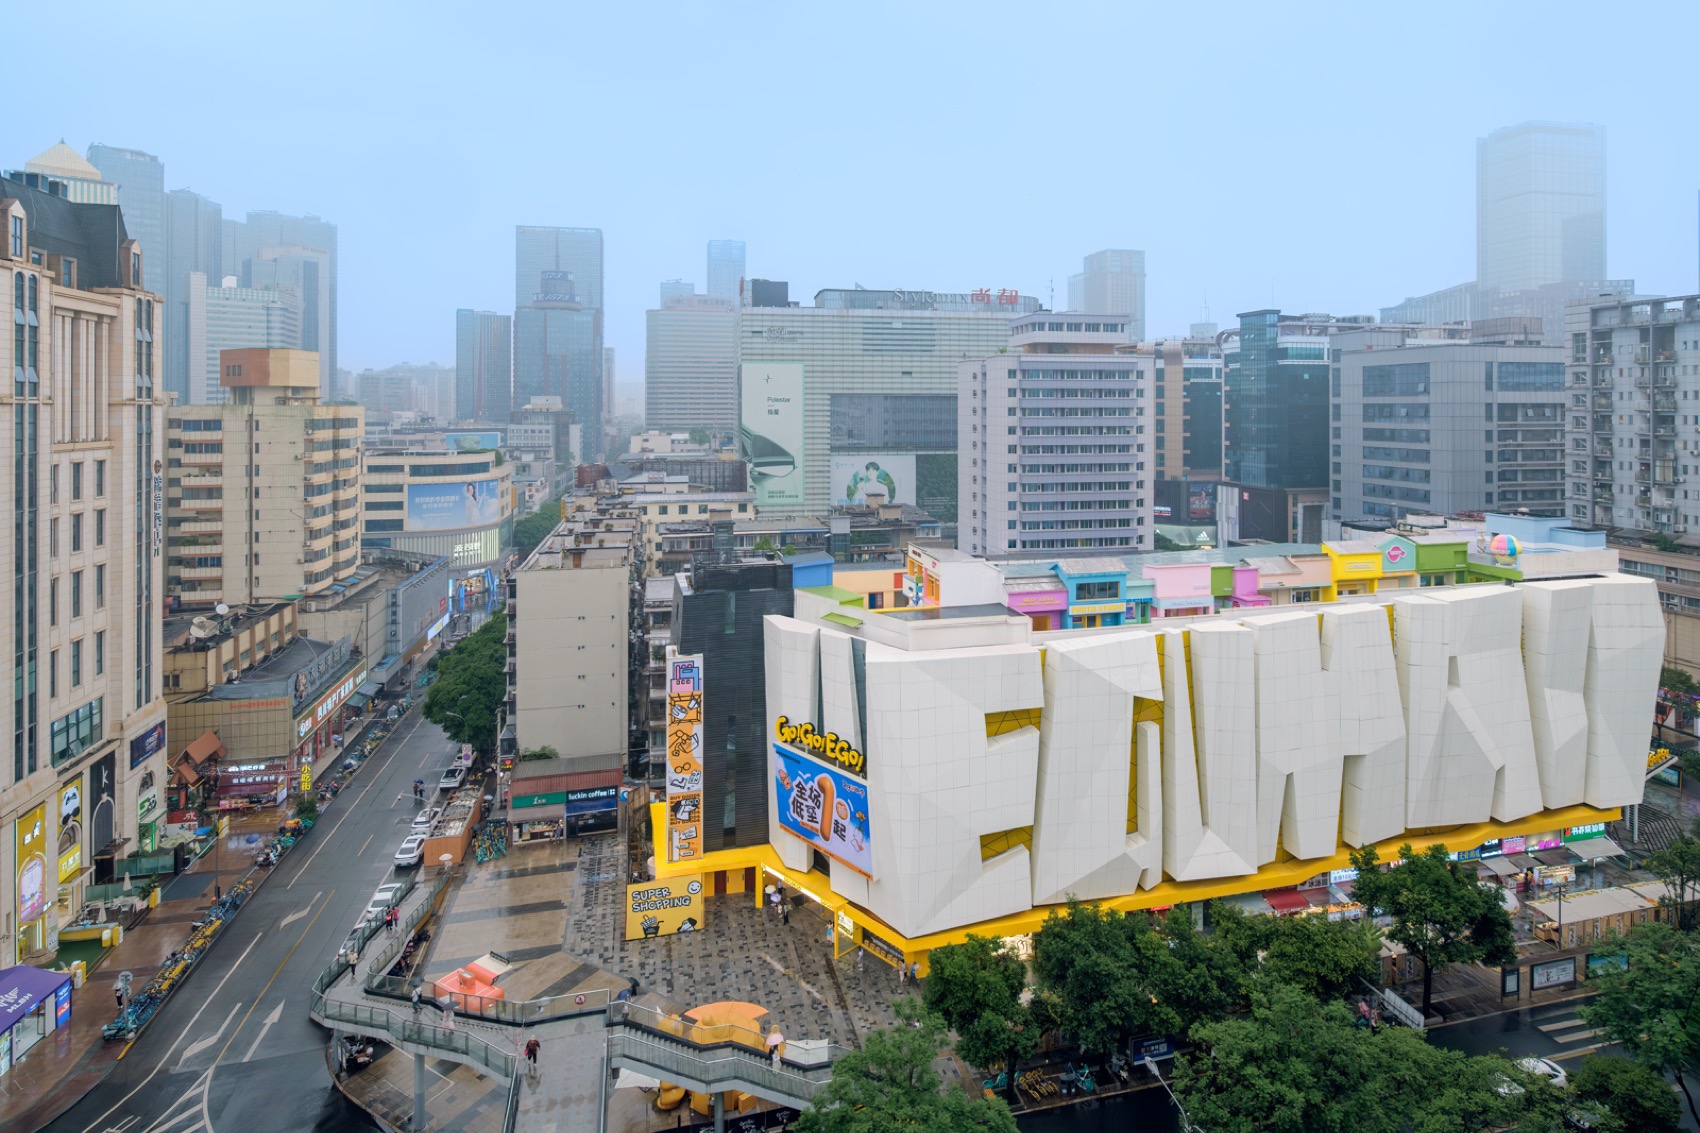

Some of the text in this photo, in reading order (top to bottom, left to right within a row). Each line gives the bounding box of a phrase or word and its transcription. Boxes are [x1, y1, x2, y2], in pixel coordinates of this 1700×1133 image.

[971, 288, 1018, 304] 尚都
[1099, 604, 1124, 612] STUDIO
[301, 764, 310, 790] 小吃街
[568, 792, 587, 800] luckin
[588, 790, 607, 798] coffee
[632, 887, 671, 901] SUPER
[632, 895, 691, 912] SHOPPING
